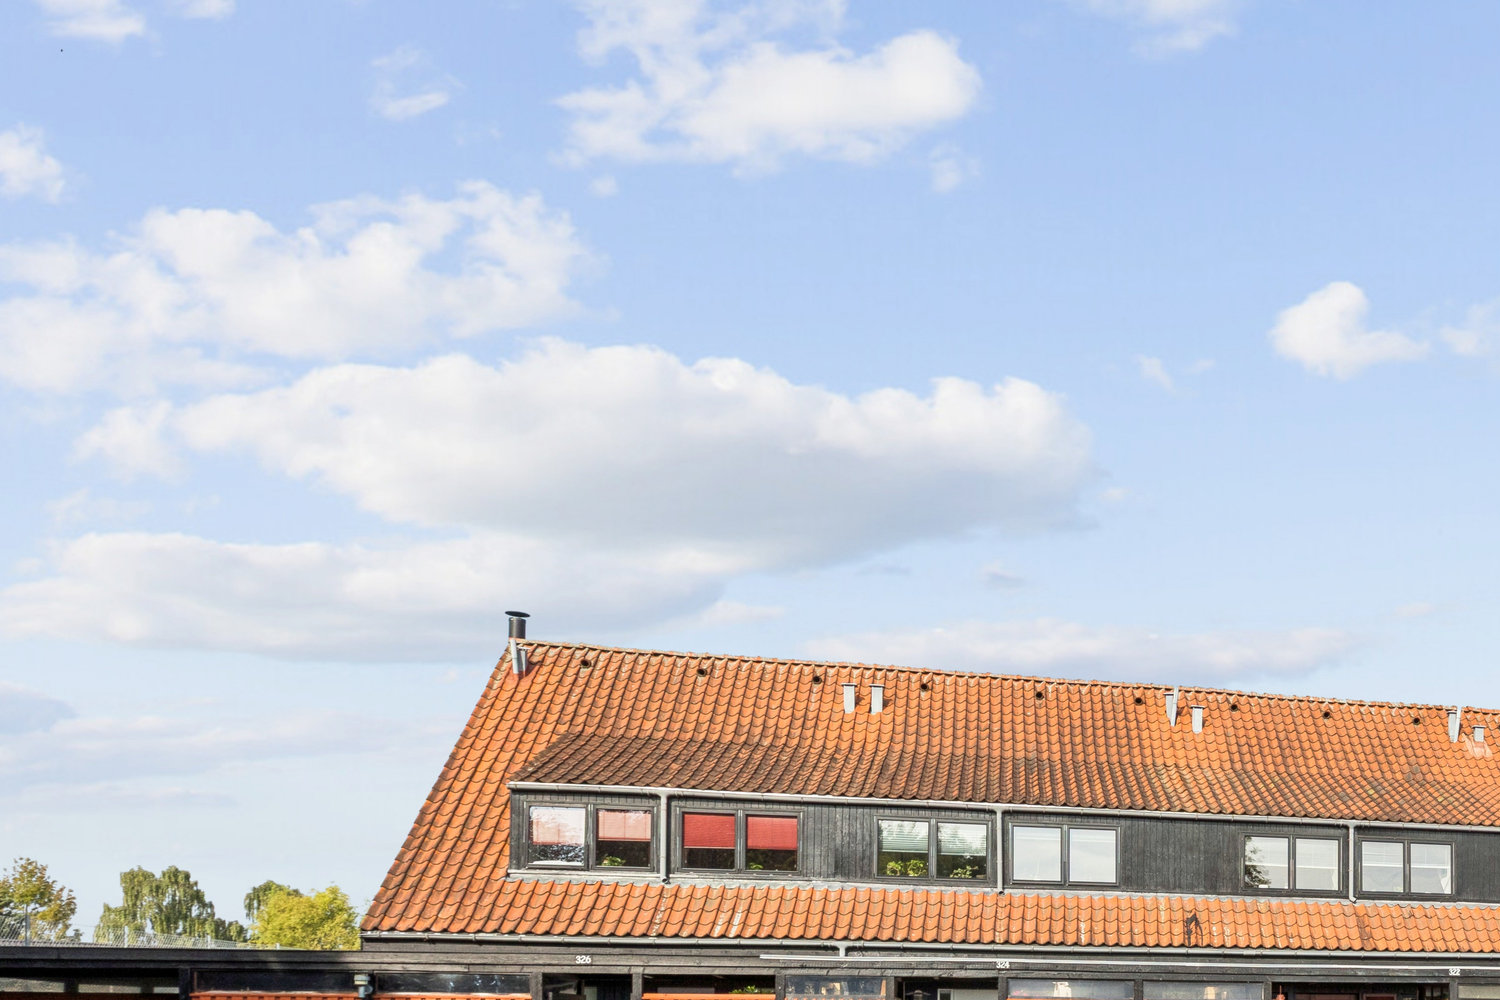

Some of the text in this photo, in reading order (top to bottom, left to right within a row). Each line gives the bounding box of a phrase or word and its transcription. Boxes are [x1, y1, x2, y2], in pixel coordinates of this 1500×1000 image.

[575, 955, 592, 964] 326
[995, 960, 1010, 969] 324
[1448, 967, 1461, 976] 322
